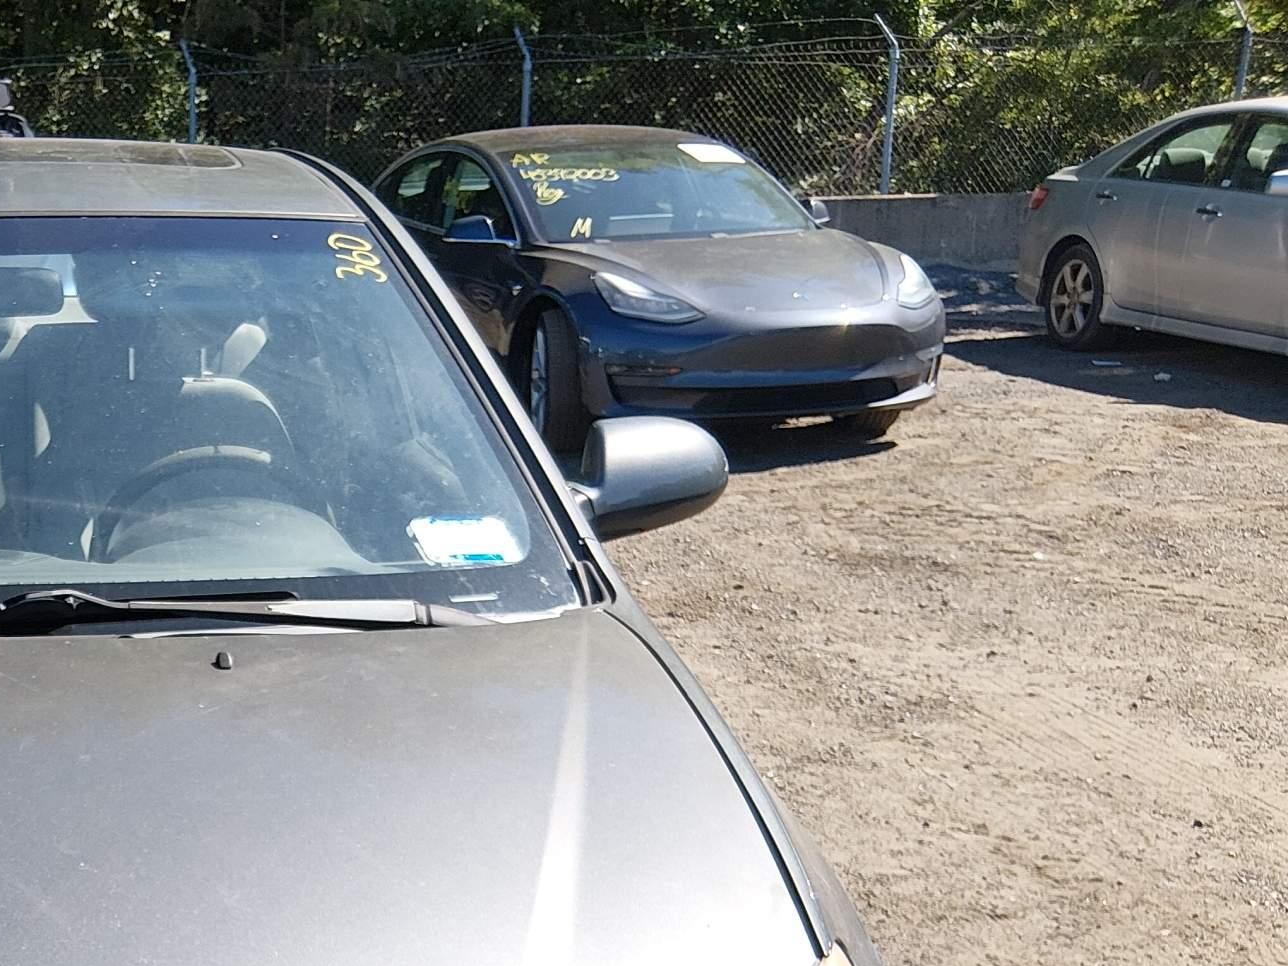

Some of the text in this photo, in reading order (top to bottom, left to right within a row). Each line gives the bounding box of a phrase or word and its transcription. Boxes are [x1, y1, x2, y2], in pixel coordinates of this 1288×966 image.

[511, 152, 550, 168] AR
[570, 216, 592, 238] M
[327, 232, 389, 284] 360
